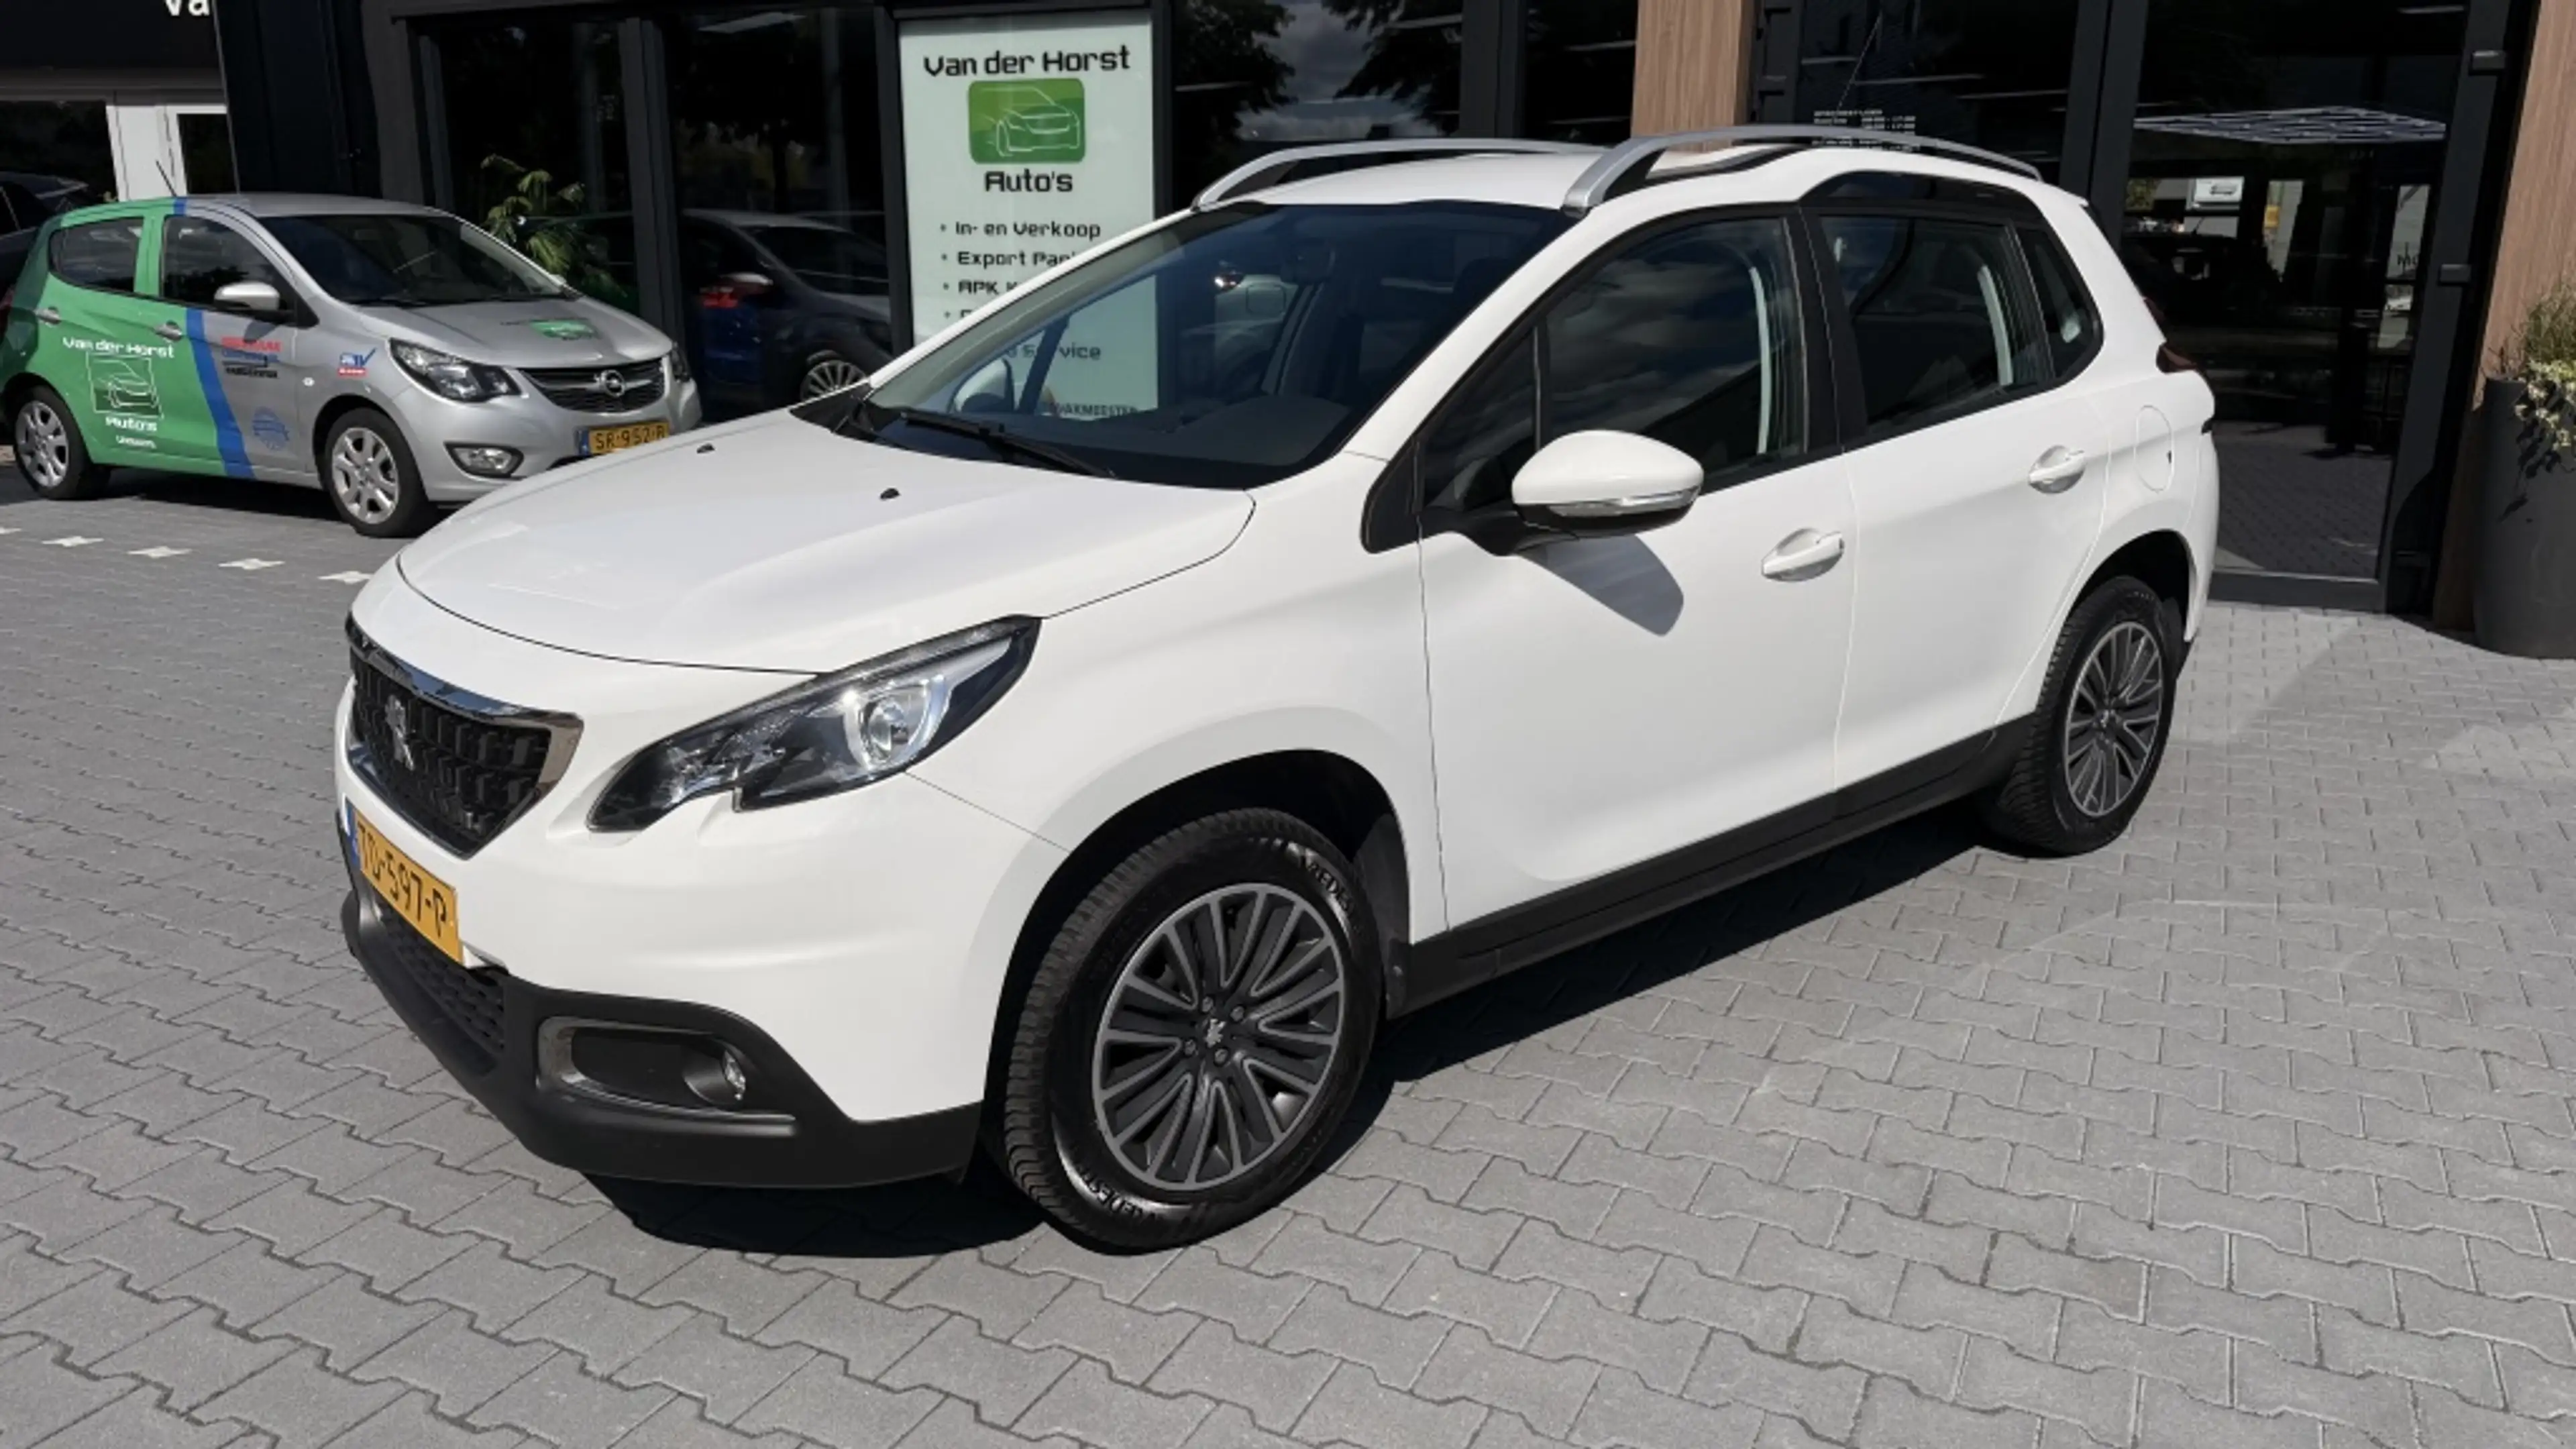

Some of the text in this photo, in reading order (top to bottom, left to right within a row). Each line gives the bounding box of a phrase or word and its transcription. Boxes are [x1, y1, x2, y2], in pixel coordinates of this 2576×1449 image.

[165, 0, 210, 16] Va
[923, 45, 1130, 76] Van der Horst
[985, 168, 1073, 193] Auto's
[983, 223, 1007, 236] en
[1013, 220, 1102, 241] Verkoop
[958, 251, 1026, 270] Export
[958, 280, 999, 294] APK
[62, 337, 175, 359] Van der Horst
[1022, 342, 1102, 360] Svice
